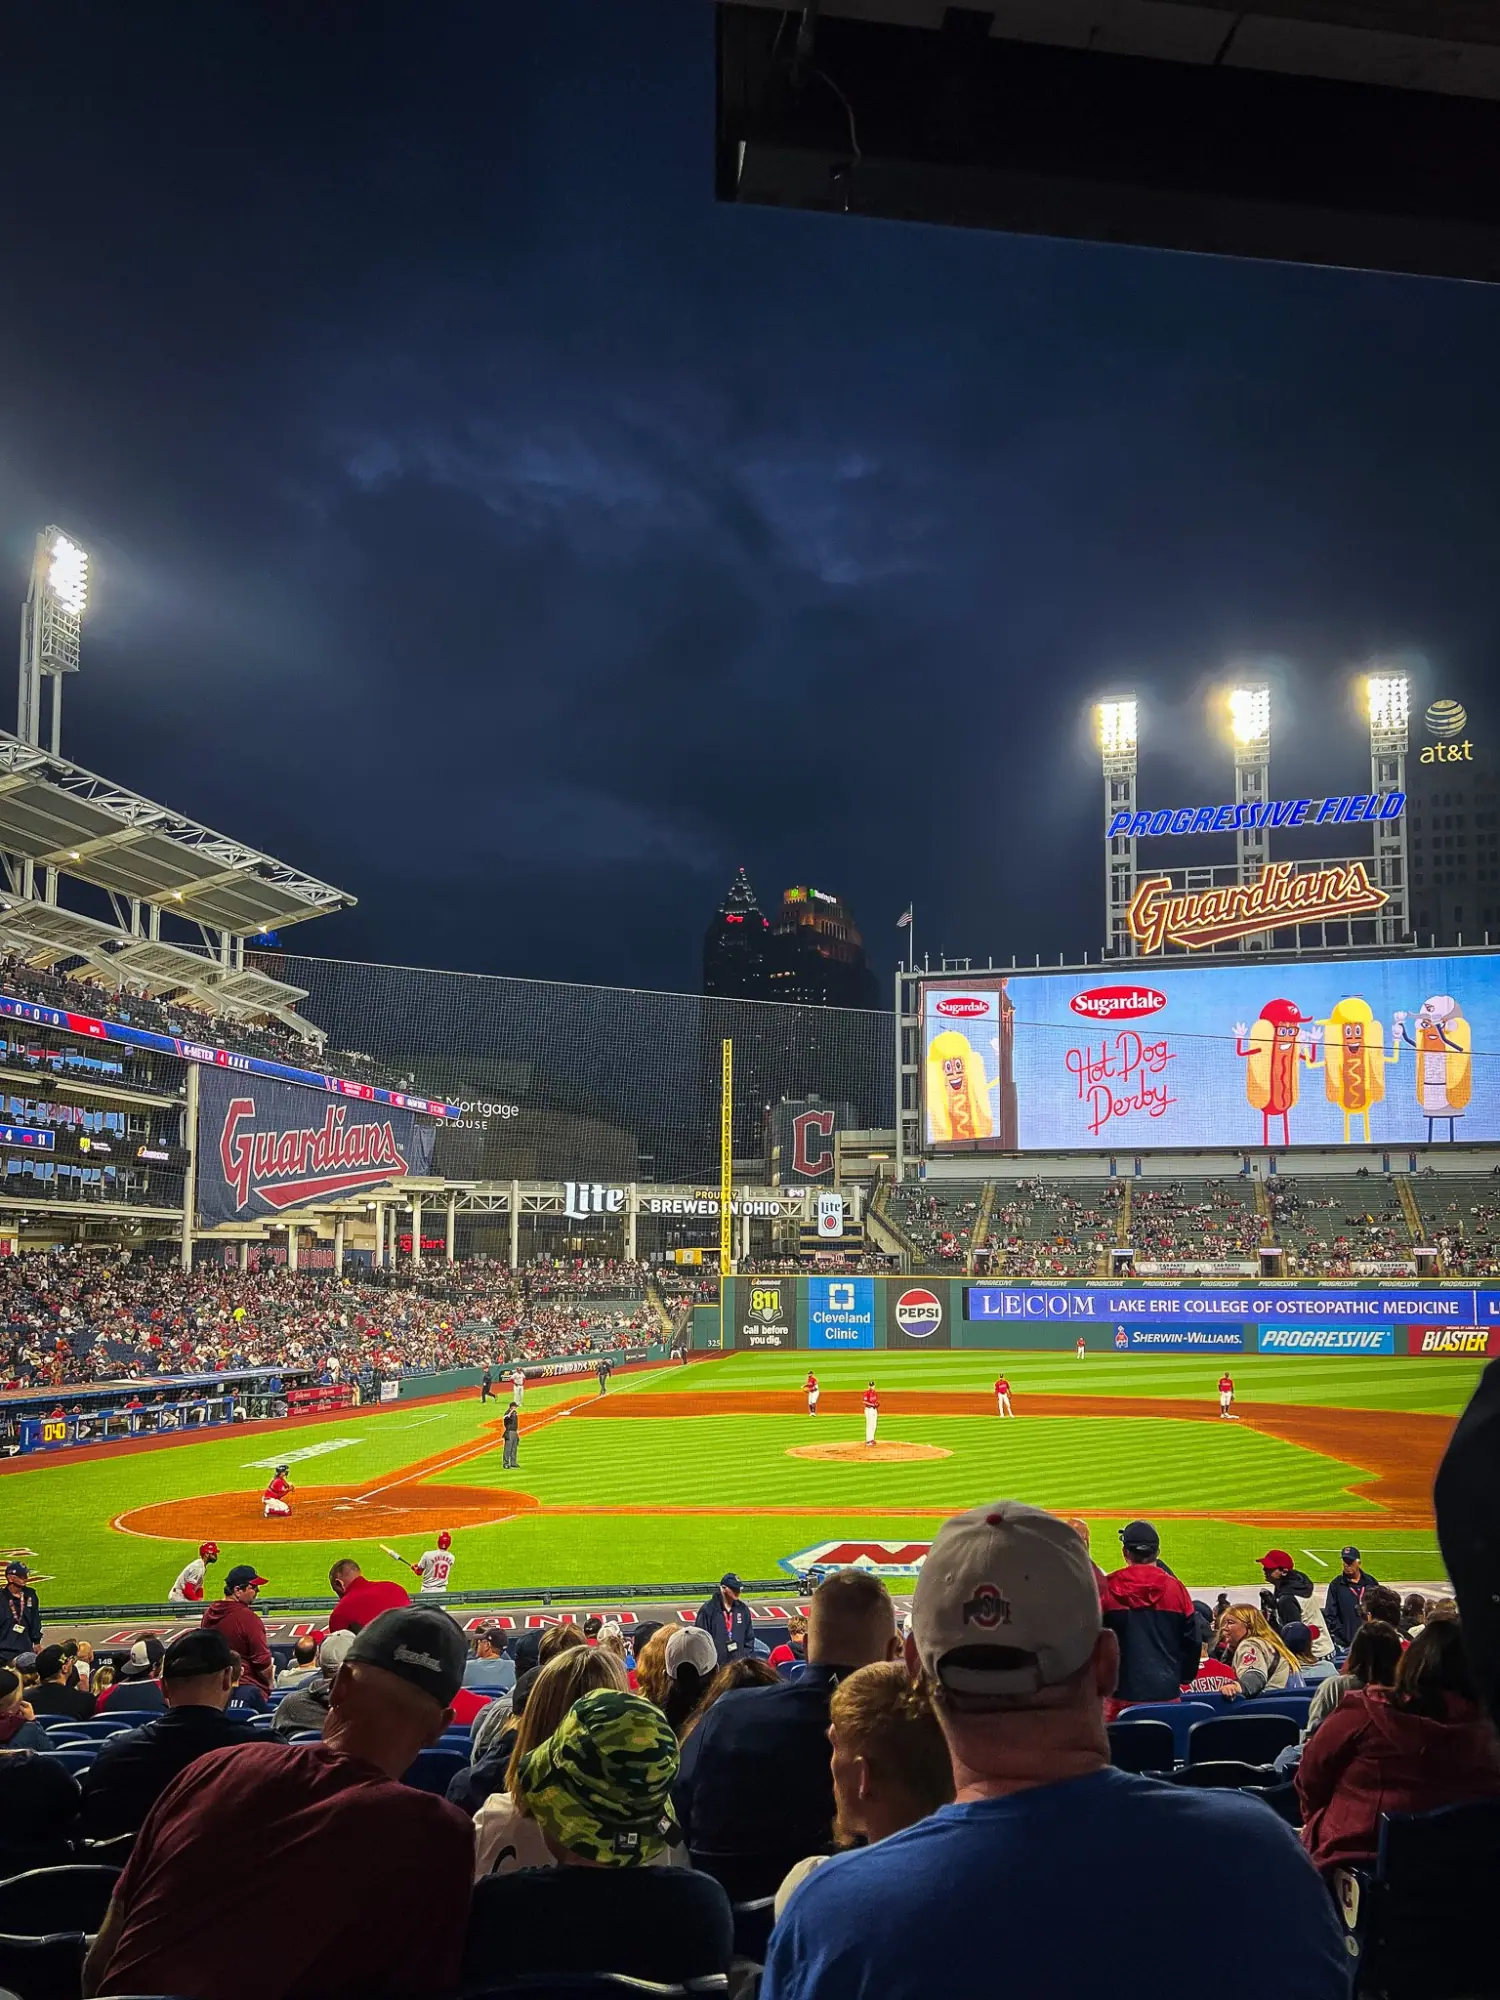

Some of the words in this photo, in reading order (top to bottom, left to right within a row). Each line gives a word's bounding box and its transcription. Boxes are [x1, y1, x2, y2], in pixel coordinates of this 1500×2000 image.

[1419, 740, 1473, 763] at&t
[1105, 799, 1310, 840] PROGRESSIVE
[1315, 792, 1407, 825] FIELD
[1127, 861, 1391, 954] Guardians
[938, 1001, 989, 1016] Sugardale
[1074, 992, 1163, 1016] Sugardale
[15, 1003, 22, 1016] 0
[33, 1008, 40, 1021] 0
[53, 1013, 59, 1025] 0
[1065, 1041, 1116, 1099] Hot
[1115, 1031, 1176, 1082] Dog
[1086, 1070, 1177, 1136] Derby
[5, 1129, 12, 1141] 4
[38, 1133, 46, 1145] 11
[792, 1109, 835, 1177] C
[220, 1097, 409, 1212] Guardians
[562, 1181, 625, 1219] Lite
[695, 1190, 738, 1200] PROUY
[650, 1199, 719, 1215] BREWED
[743, 1201, 780, 1216] OHIO
[820, 1201, 841, 1214] Lite
[753, 1290, 778, 1310] 811
[1109, 1300, 1147, 1312] LAKE
[1150, 1300, 1181, 1313] ERIE
[1183, 1300, 1250, 1313] COLLEGE
[1253, 1301, 1274, 1313] OF
[1276, 1301, 1379, 1314] OSTEOPATHIC
[1383, 1302, 1459, 1314] MEDICINE
[813, 1311, 870, 1324] Cleveland
[899, 1307, 940, 1319] PEPSI
[743, 1325, 759, 1335] Call
[762, 1325, 789, 1335] before
[825, 1327, 858, 1340] Clinic
[750, 1336, 765, 1346] you
[766, 1335, 782, 1346] dig.
[1262, 1331, 1383, 1348] PROGRESSIVE
[1421, 1331, 1489, 1351] BLASTER
[433, 1563, 449, 1580] 13
[98, 1658, 113, 1666] 148
